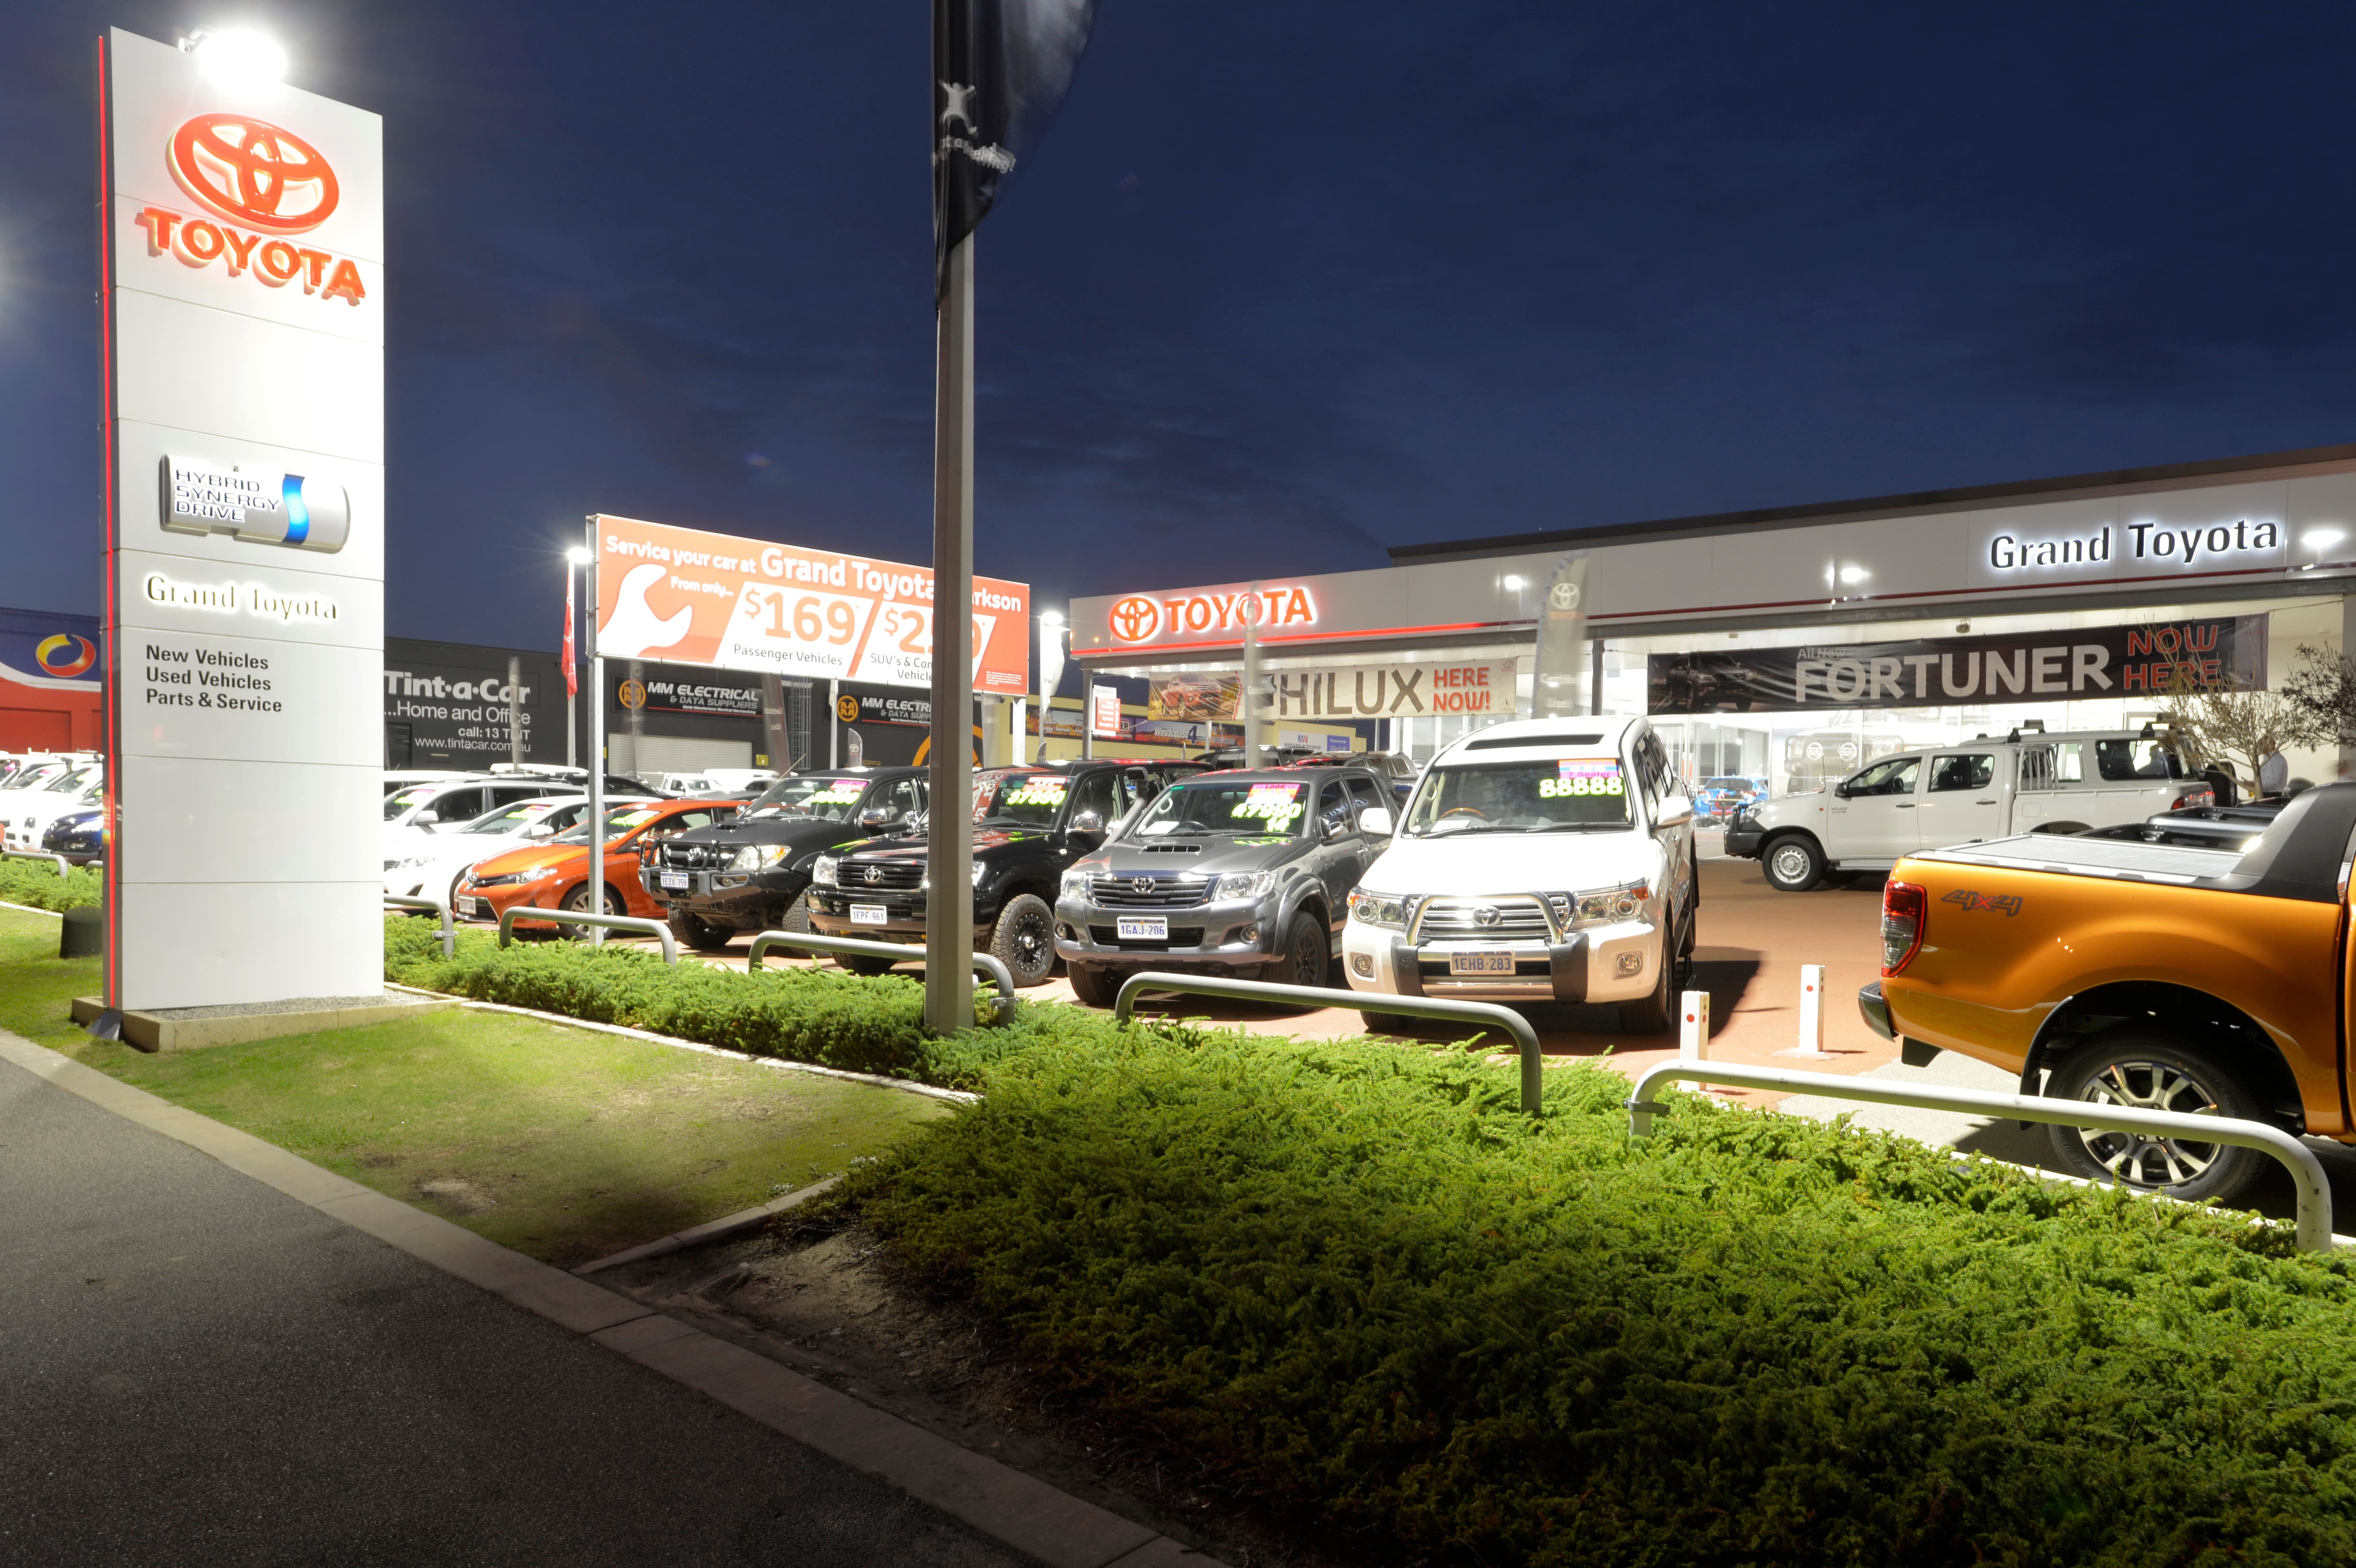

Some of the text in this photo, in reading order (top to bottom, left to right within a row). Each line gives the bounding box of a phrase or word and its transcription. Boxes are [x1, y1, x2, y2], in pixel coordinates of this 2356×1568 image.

[139, 207, 366, 302] TOYOTA
[175, 469, 260, 492] HYBRID
[175, 484, 280, 511] SYNERGY
[175, 500, 245, 522] DRIVE
[1990, 519, 2279, 570] Grand Toyota
[606, 535, 670, 561] Service
[673, 549, 710, 566] your
[712, 555, 738, 570] car
[740, 558, 756, 573] at
[761, 547, 846, 588] Grand
[671, 576, 700, 591] From
[146, 576, 337, 620] Grand Toyota
[1164, 588, 1314, 632] TOYOTA
[2128, 625, 2219, 656] NOW
[146, 644, 269, 669] New Vehicles
[734, 644, 842, 665] Passenger Vehicles
[871, 653, 901, 666] SUV's
[904, 656, 911, 667] &
[1798, 648, 1846, 659] All New
[146, 666, 271, 691] Used Vehicles
[897, 669, 932, 681] Vehicle
[1434, 667, 1490, 687] HERE
[1796, 644, 2113, 703] FORTUNER
[2124, 659, 2221, 690] HERE
[146, 688, 282, 712] Parts & Service
[647, 682, 758, 701] MM ELECTRICAL
[1279, 668, 1424, 716] HILUX
[1433, 691, 1490, 711] NOW!
[679, 696, 704, 705] DATA
[708, 698, 757, 709] SUPPLIERS
[862, 697, 884, 708] MM
[451, 706, 481, 721] and
[458, 727, 482, 738] call:
[485, 727, 499, 739] 13
[1154, 726, 1189, 739] Westcoast
[415, 738, 530, 752] www.tintacar.comau
[1539, 776, 1624, 798] 88888
[1007, 790, 1066, 806] 37990
[1266, 817, 1290, 833] 14
